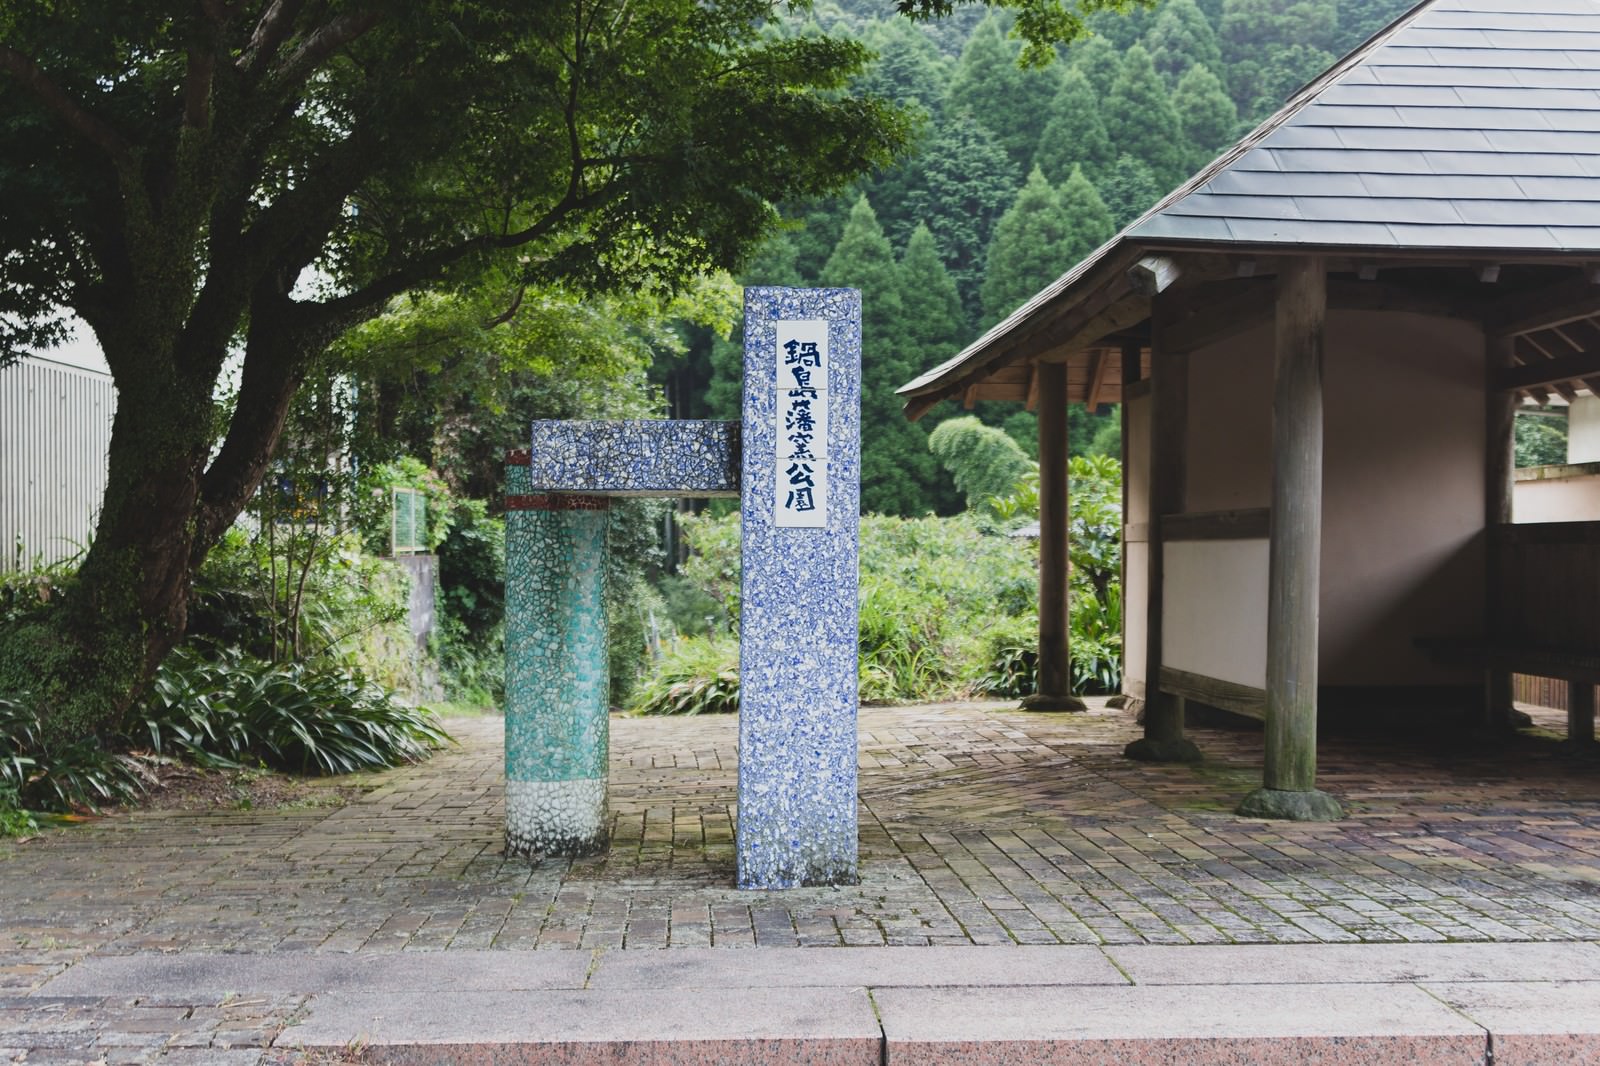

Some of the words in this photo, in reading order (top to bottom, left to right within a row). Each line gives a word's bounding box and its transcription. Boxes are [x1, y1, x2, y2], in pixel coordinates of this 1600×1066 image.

[783, 339, 821, 511] 鍋島藩窯公園
